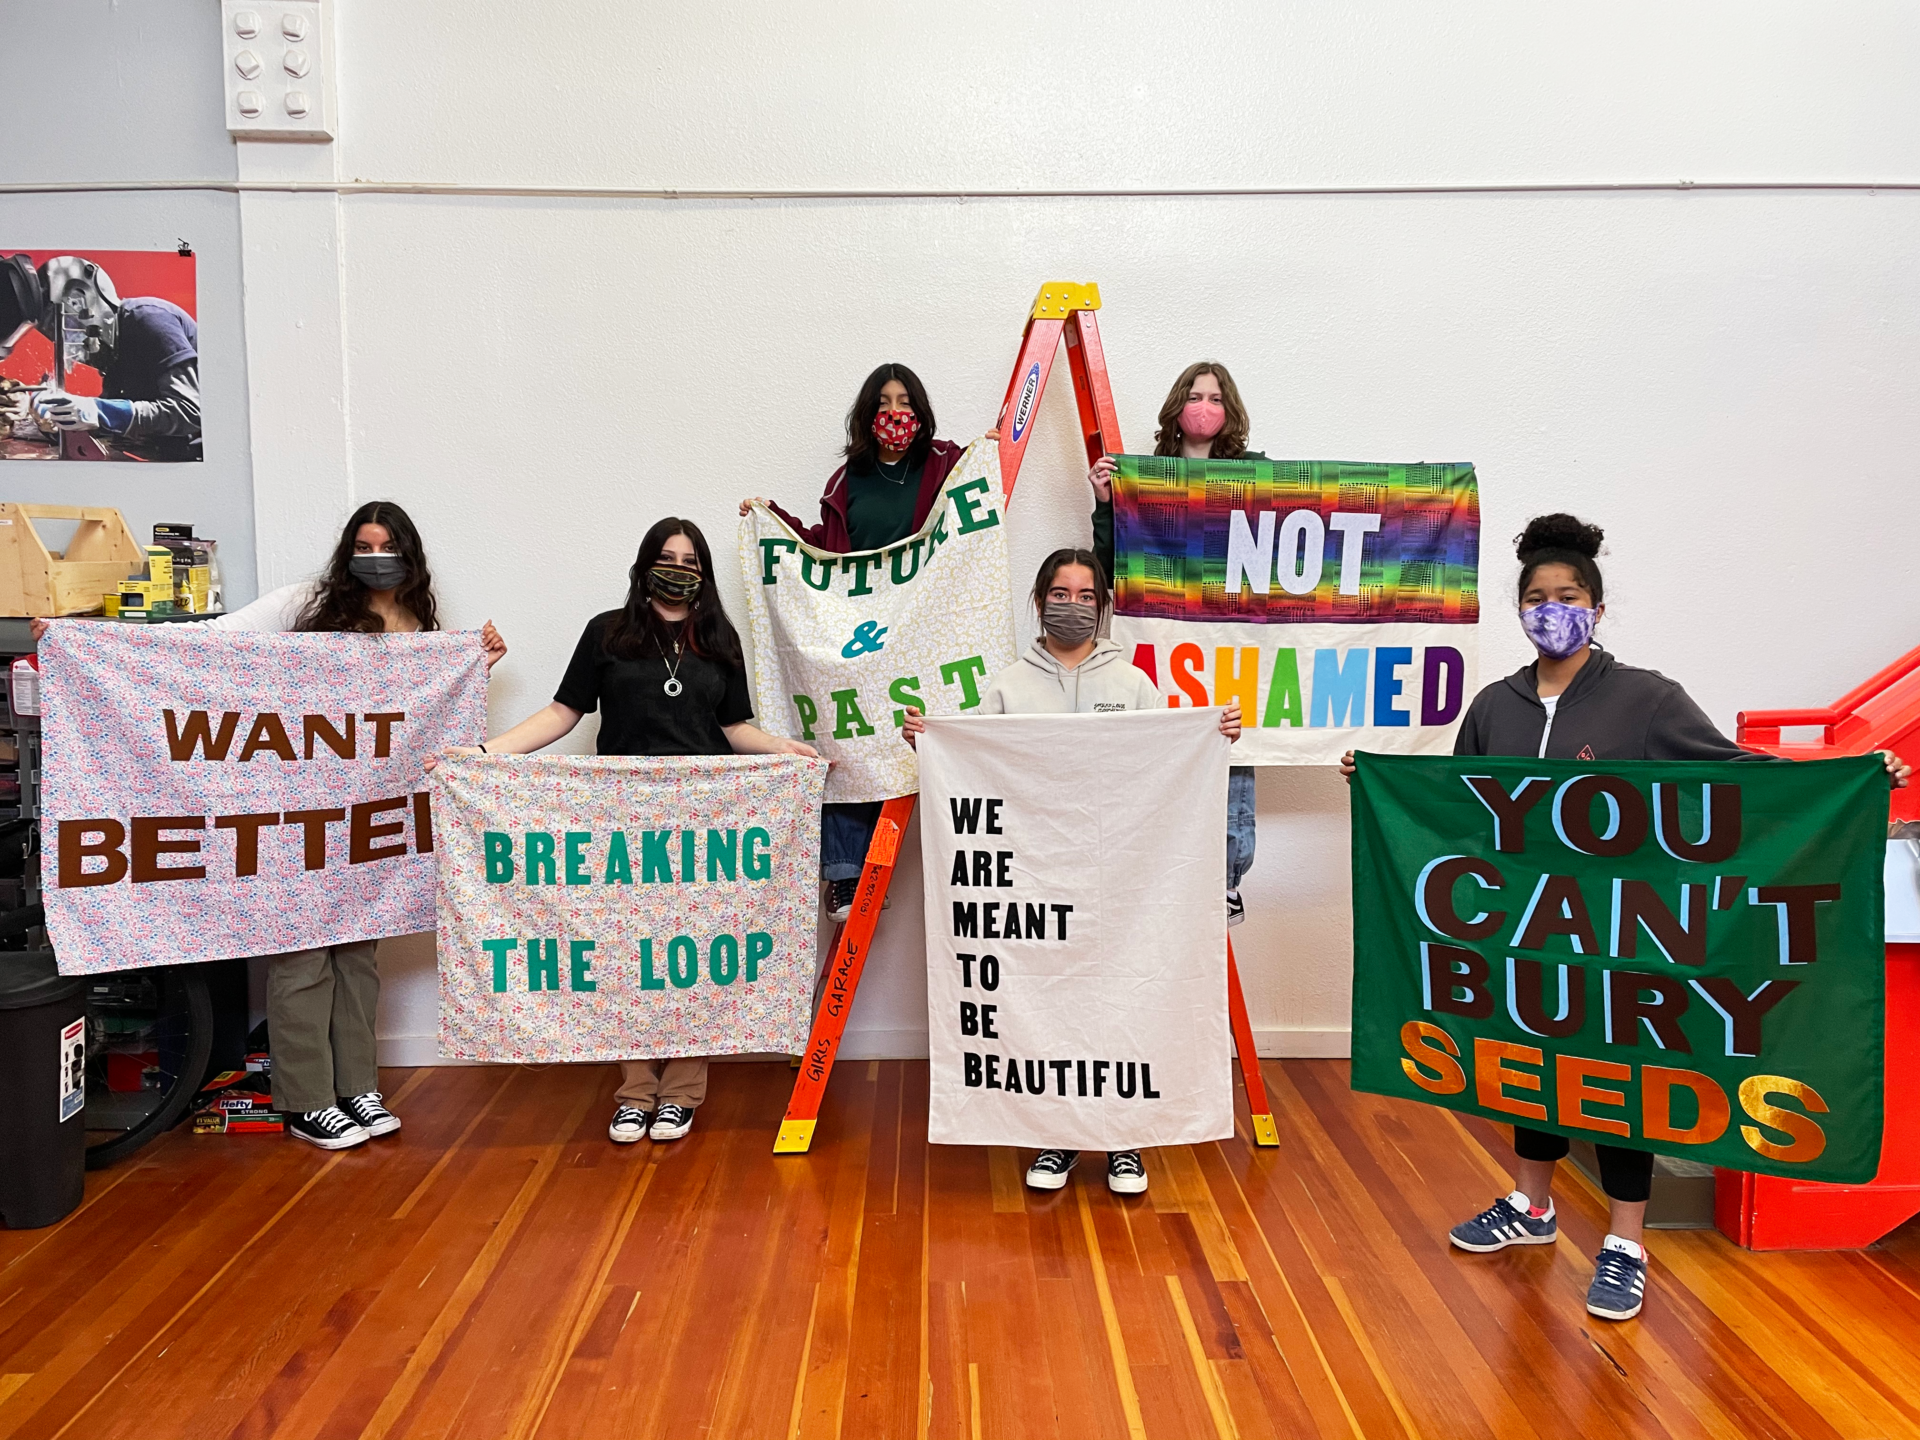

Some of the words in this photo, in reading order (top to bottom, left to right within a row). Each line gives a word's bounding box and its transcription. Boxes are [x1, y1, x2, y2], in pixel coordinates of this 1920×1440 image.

[1017, 378, 1036, 426] WERNER
[1225, 509, 1382, 595] NOT
[841, 620, 889, 659] &
[792, 655, 987, 742] PAST
[162, 708, 405, 762] WANT
[950, 797, 1004, 836] WE
[1460, 774, 1742, 863] YOU
[483, 826, 772, 887] BREAKING
[950, 849, 1014, 888] ARE
[952, 901, 1074, 941] MEANT
[1414, 854, 1841, 966] CAN'T
[482, 938, 597, 993] THE
[639, 931, 774, 991] LOOP
[956, 953, 1000, 992] TO
[806, 1038, 831, 1082] GIRLS
[827, 937, 858, 1017] GARAGE
[960, 1000, 999, 1039] BE
[1419, 940, 1801, 1058] BURY
[963, 1051, 1161, 1099] BEAUTIFUL
[1400, 1020, 1830, 1163] SEEDS
[220, 1100, 252, 1109] Hefty
